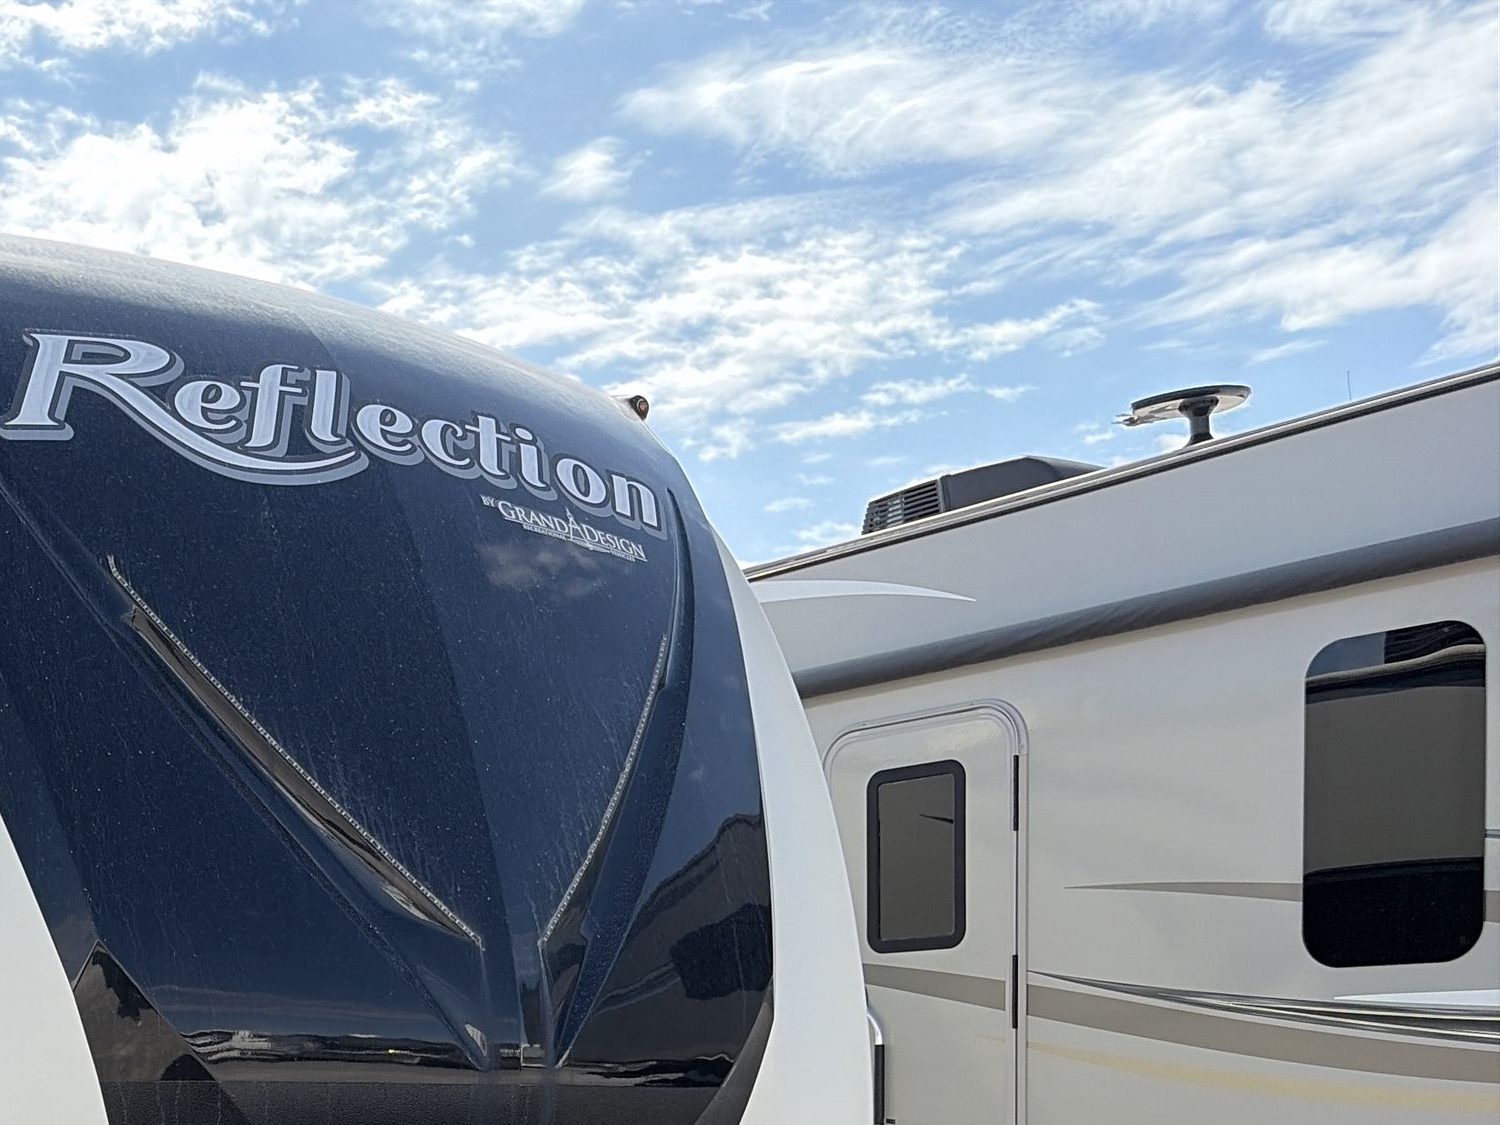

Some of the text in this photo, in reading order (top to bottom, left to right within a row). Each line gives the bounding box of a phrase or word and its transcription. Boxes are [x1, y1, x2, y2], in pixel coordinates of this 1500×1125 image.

[480, 494, 646, 560] BY GRAND DESIGN
